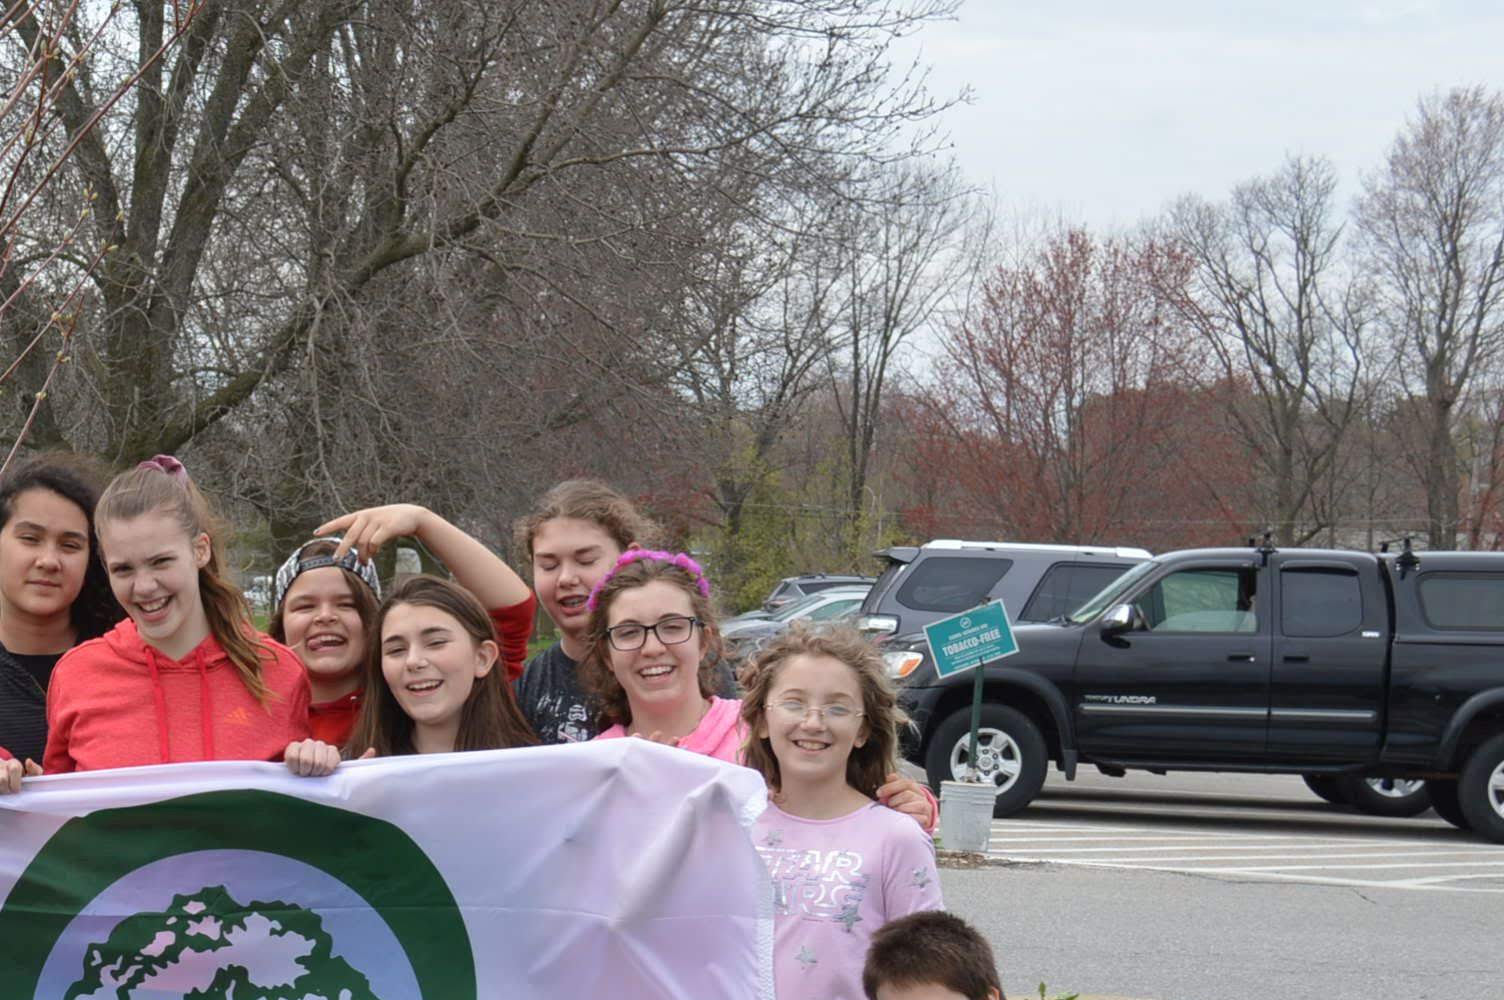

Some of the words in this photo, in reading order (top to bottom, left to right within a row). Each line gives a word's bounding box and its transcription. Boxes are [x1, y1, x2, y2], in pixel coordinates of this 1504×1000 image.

[942, 629, 1001, 656] TOBACCO-FREE
[1106, 695, 1156, 704] TUNDRA
[755, 846, 864, 885] TAR
